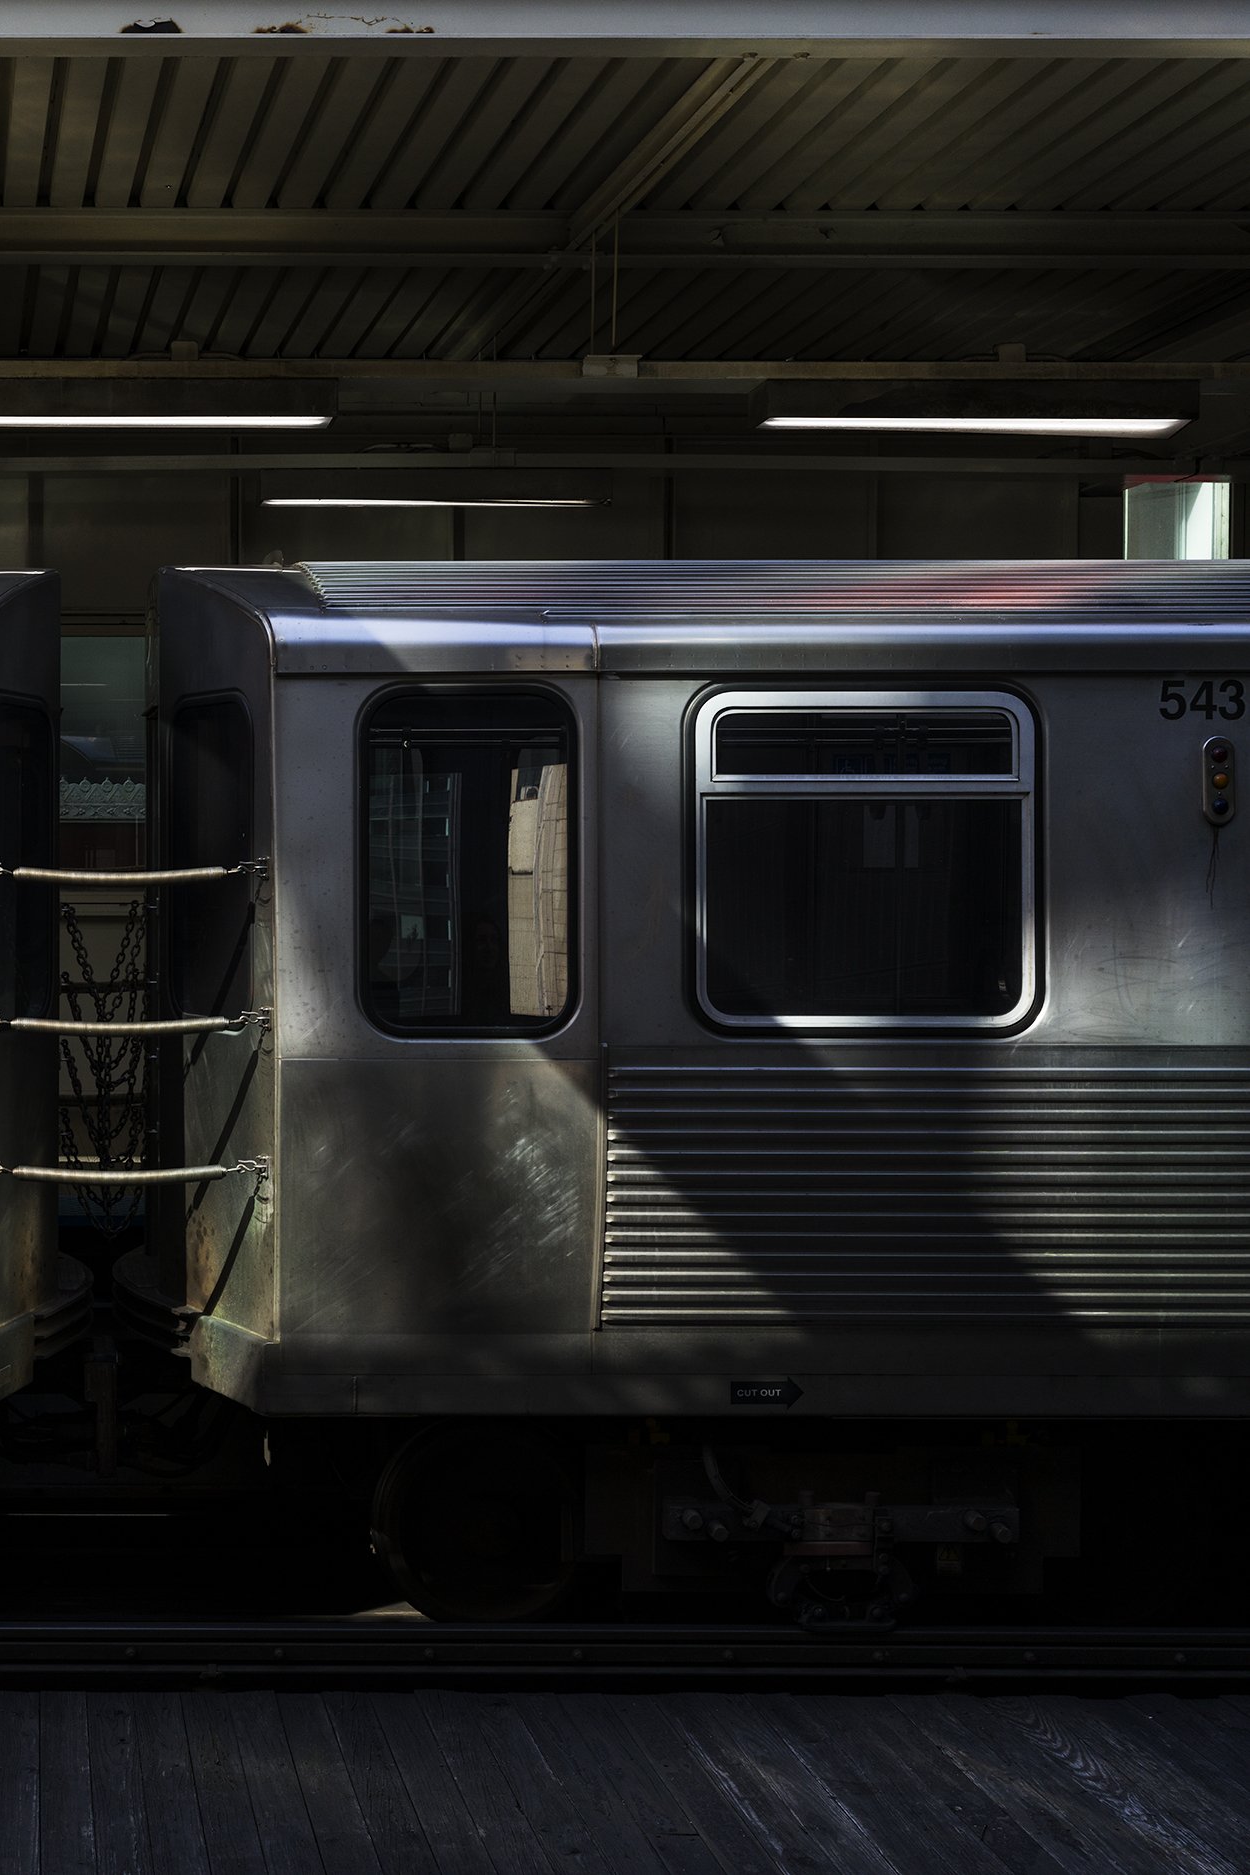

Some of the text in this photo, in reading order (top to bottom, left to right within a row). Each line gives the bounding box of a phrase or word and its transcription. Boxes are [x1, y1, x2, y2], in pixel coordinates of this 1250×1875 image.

[1159, 679, 1246, 720] 543
[736, 1388, 782, 1398] CUT OUT
